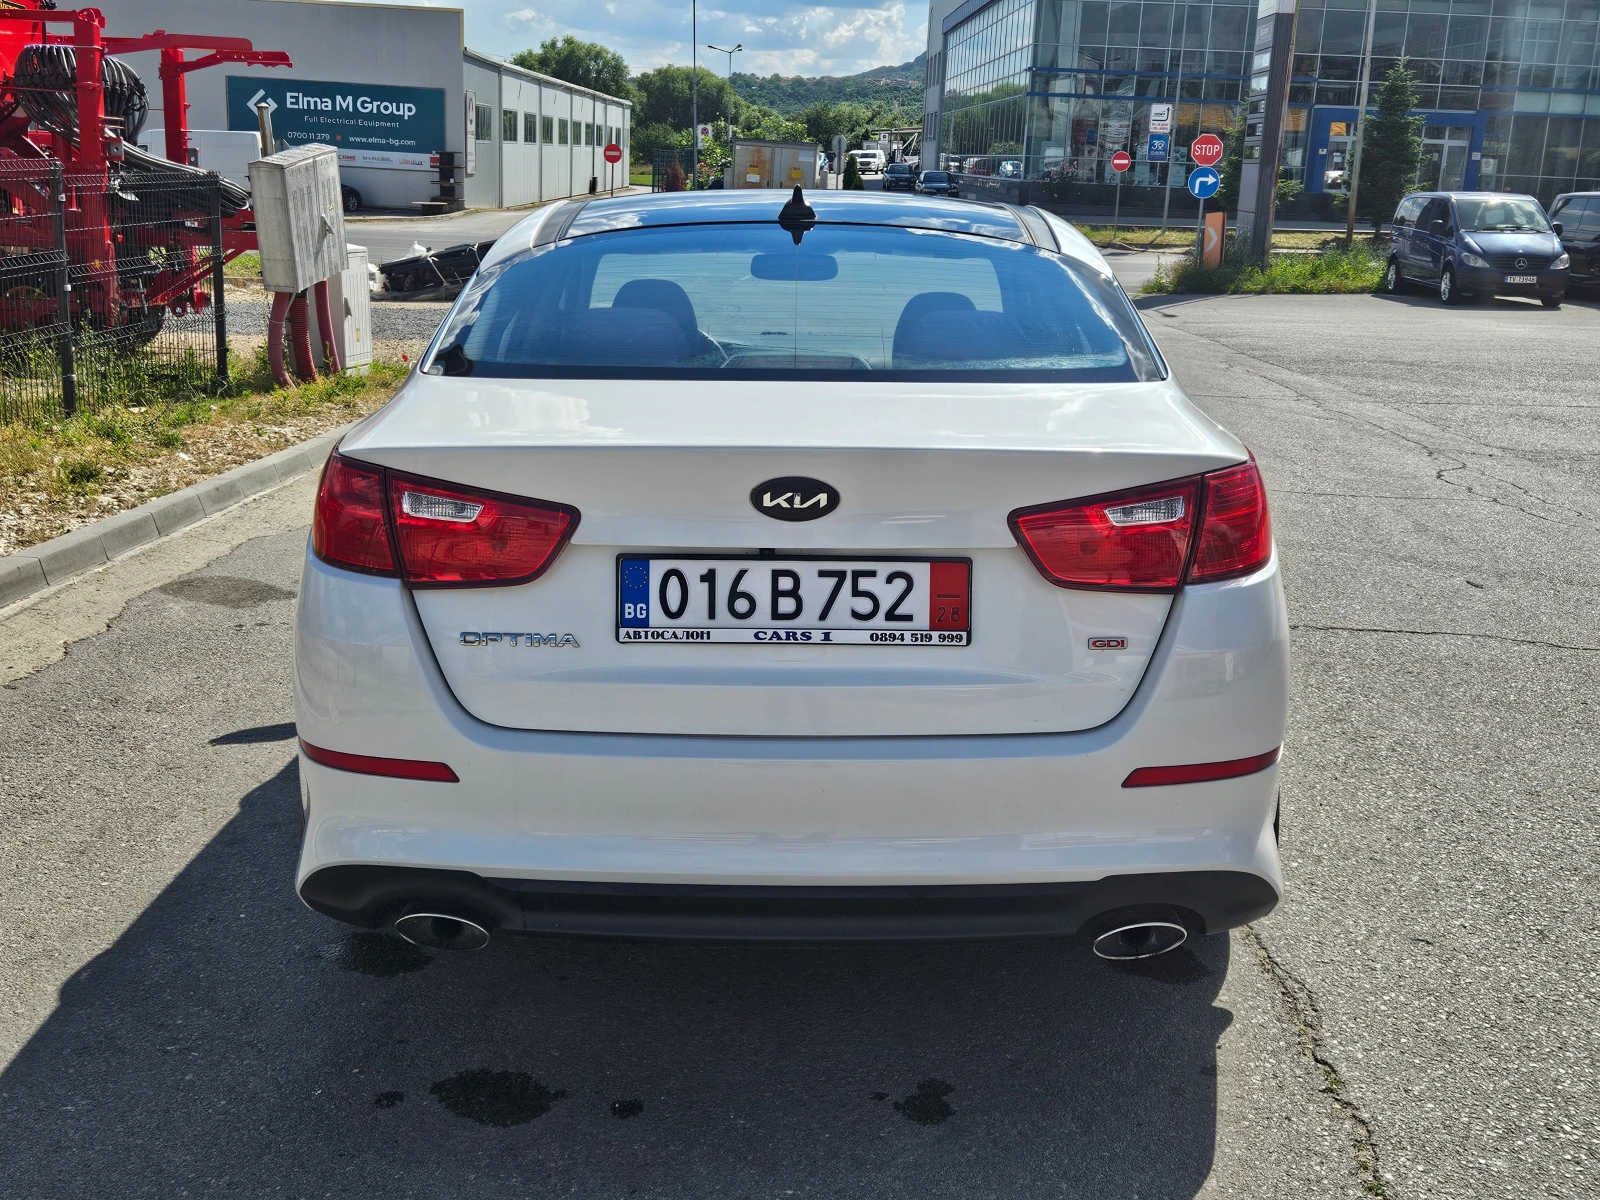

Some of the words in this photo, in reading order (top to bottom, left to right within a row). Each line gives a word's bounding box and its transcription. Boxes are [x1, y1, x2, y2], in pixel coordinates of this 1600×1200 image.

[286, 92, 332, 110] Elma
[336, 95, 352, 112] M
[356, 96, 416, 120] Group
[320, 117, 356, 125] Electrical
[358, 119, 399, 128] Equipment
[287, 131, 307, 139] 0700
[348, 136, 416, 146] www.elma-bg.com
[1194, 144, 1220, 156] STOP
[762, 491, 828, 509] KIA
[658, 568, 757, 621] 016
[770, 569, 803, 621] B
[817, 569, 915, 622] 752
[624, 603, 647, 619] BG
[936, 606, 961, 623] 28
[459, 631, 581, 648] OPTIMA
[623, 630, 711, 641] АВТОСАЛОН
[753, 630, 812, 642] CARS
[819, 631, 833, 642] 1
[869, 632, 905, 642] 0894
[910, 632, 933, 643] 519
[938, 633, 964, 643] 999
[1091, 639, 1125, 648] GDI
